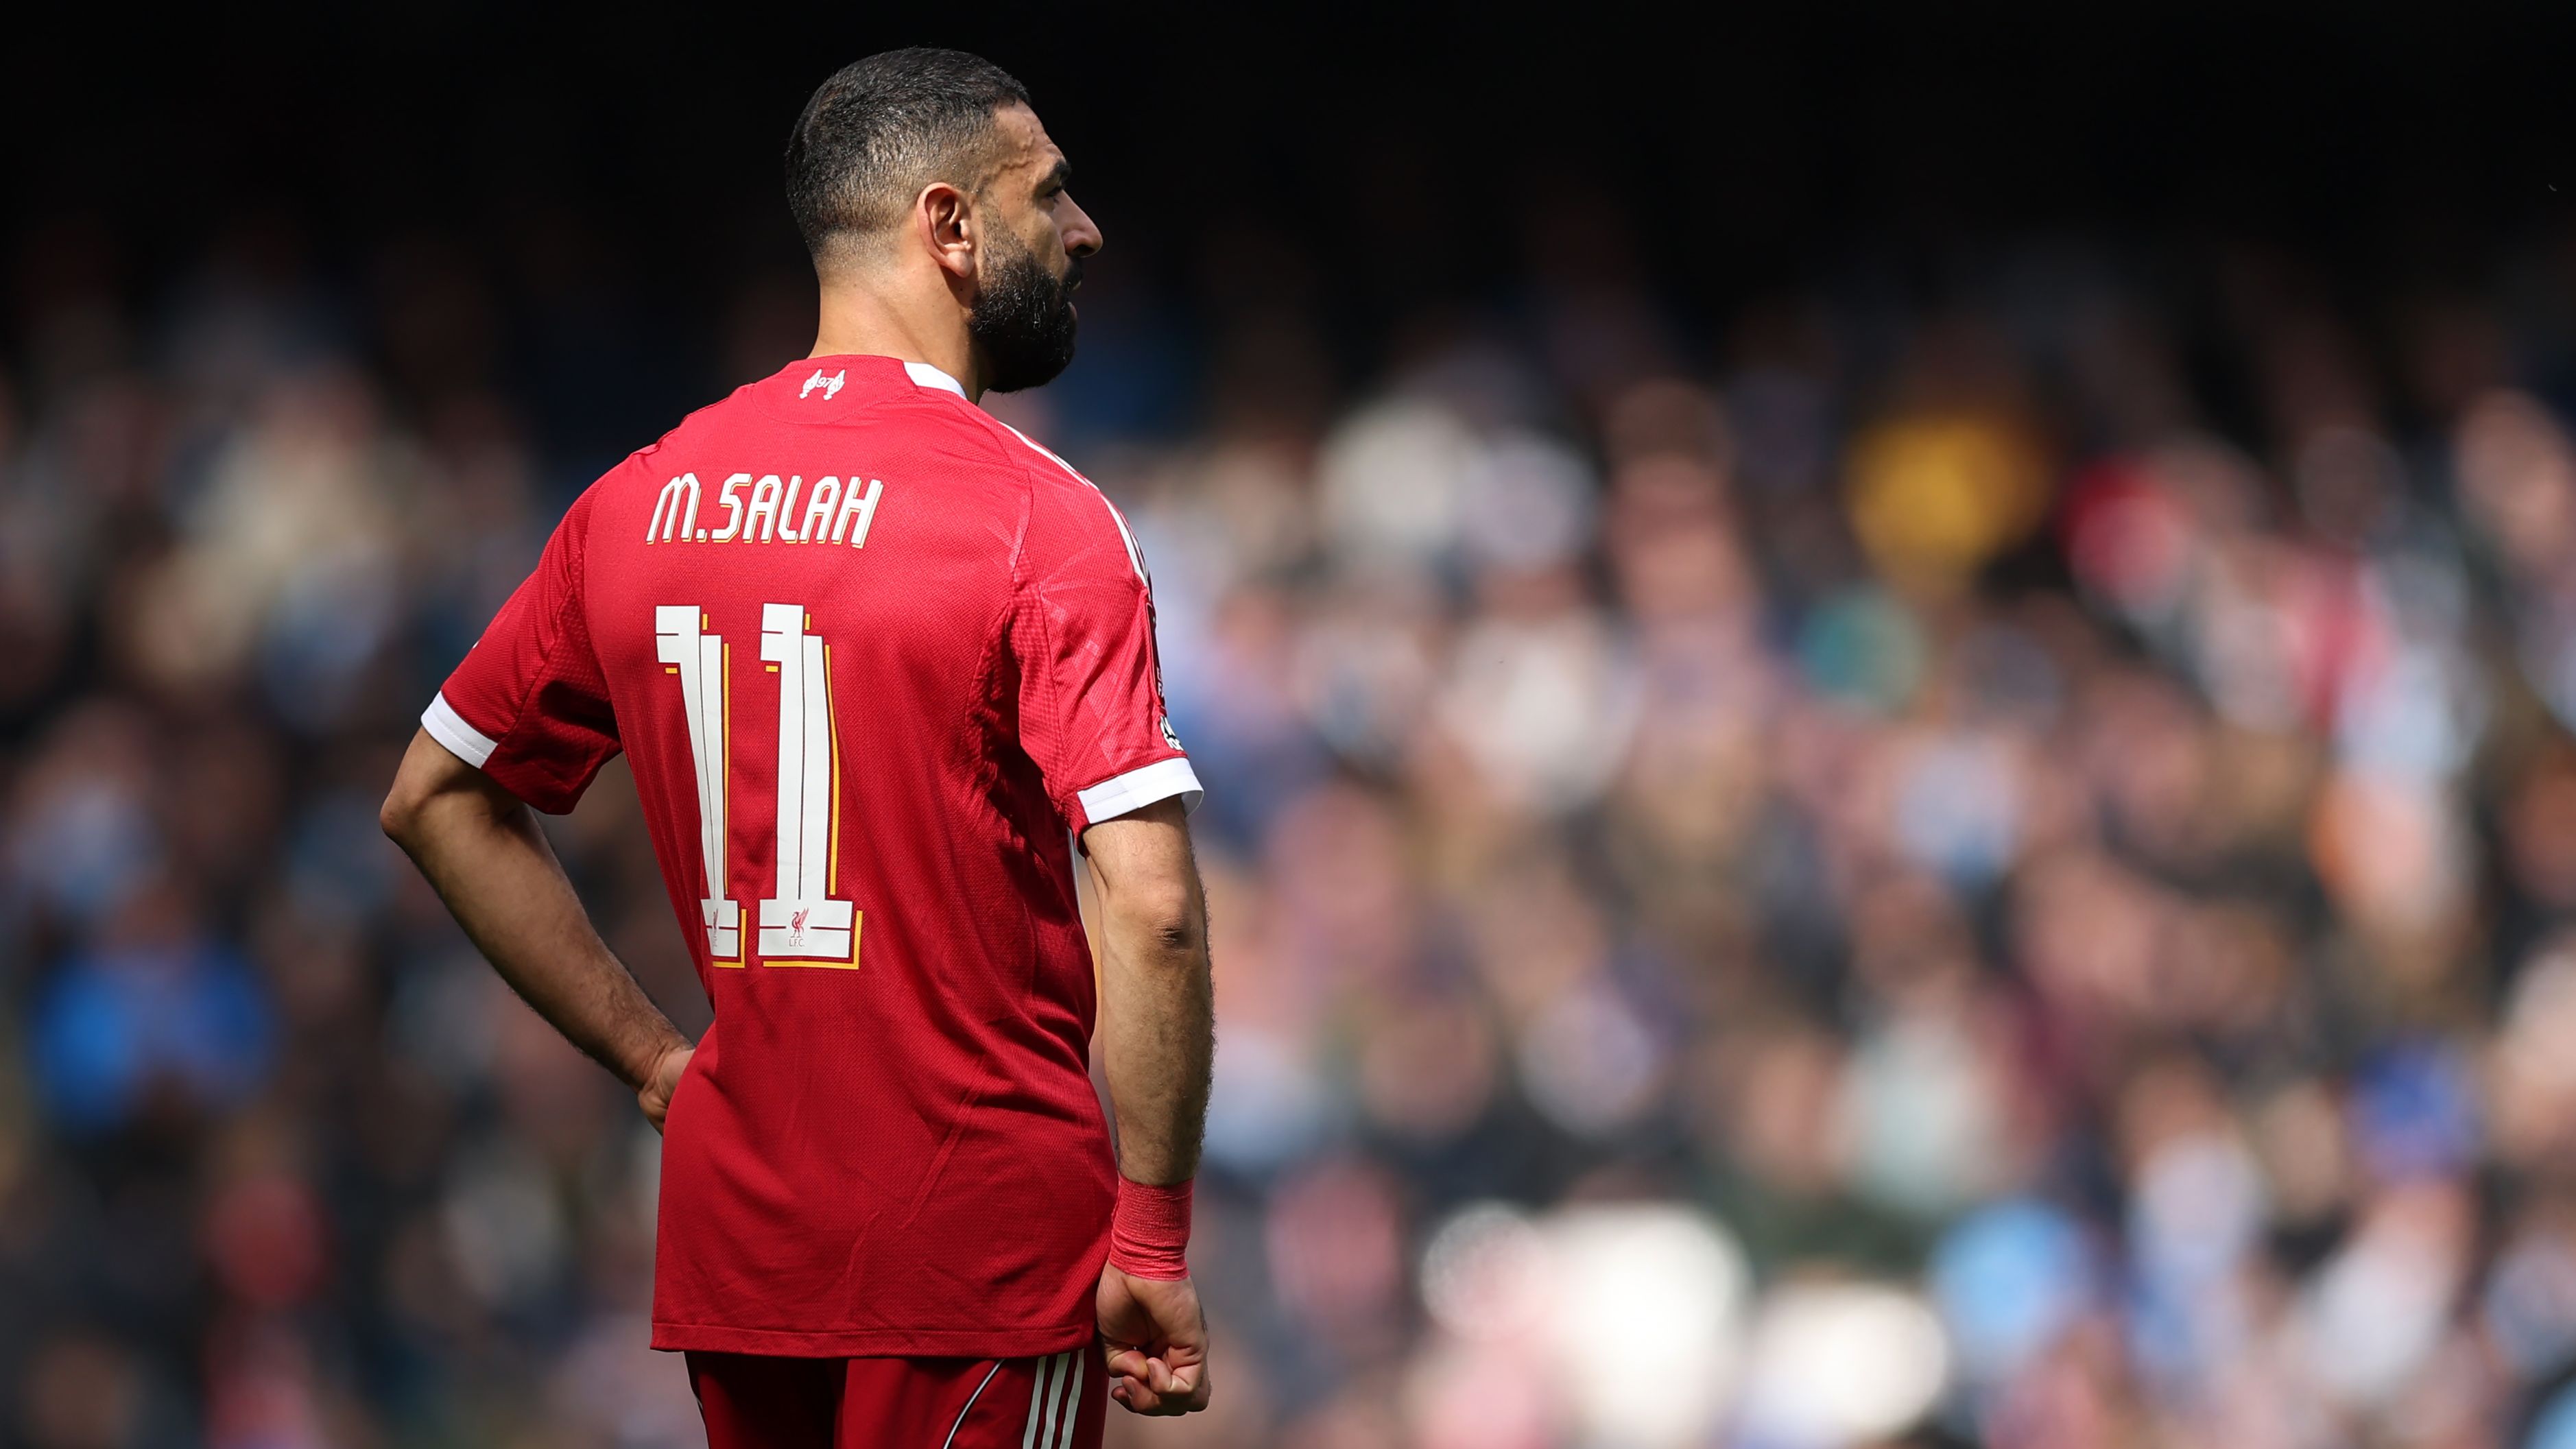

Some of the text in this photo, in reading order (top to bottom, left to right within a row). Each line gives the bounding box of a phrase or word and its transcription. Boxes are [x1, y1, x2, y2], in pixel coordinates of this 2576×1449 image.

[816, 376, 835, 387] 97
[646, 472, 883, 549] M.SALAH
[656, 603, 863, 970] 11
